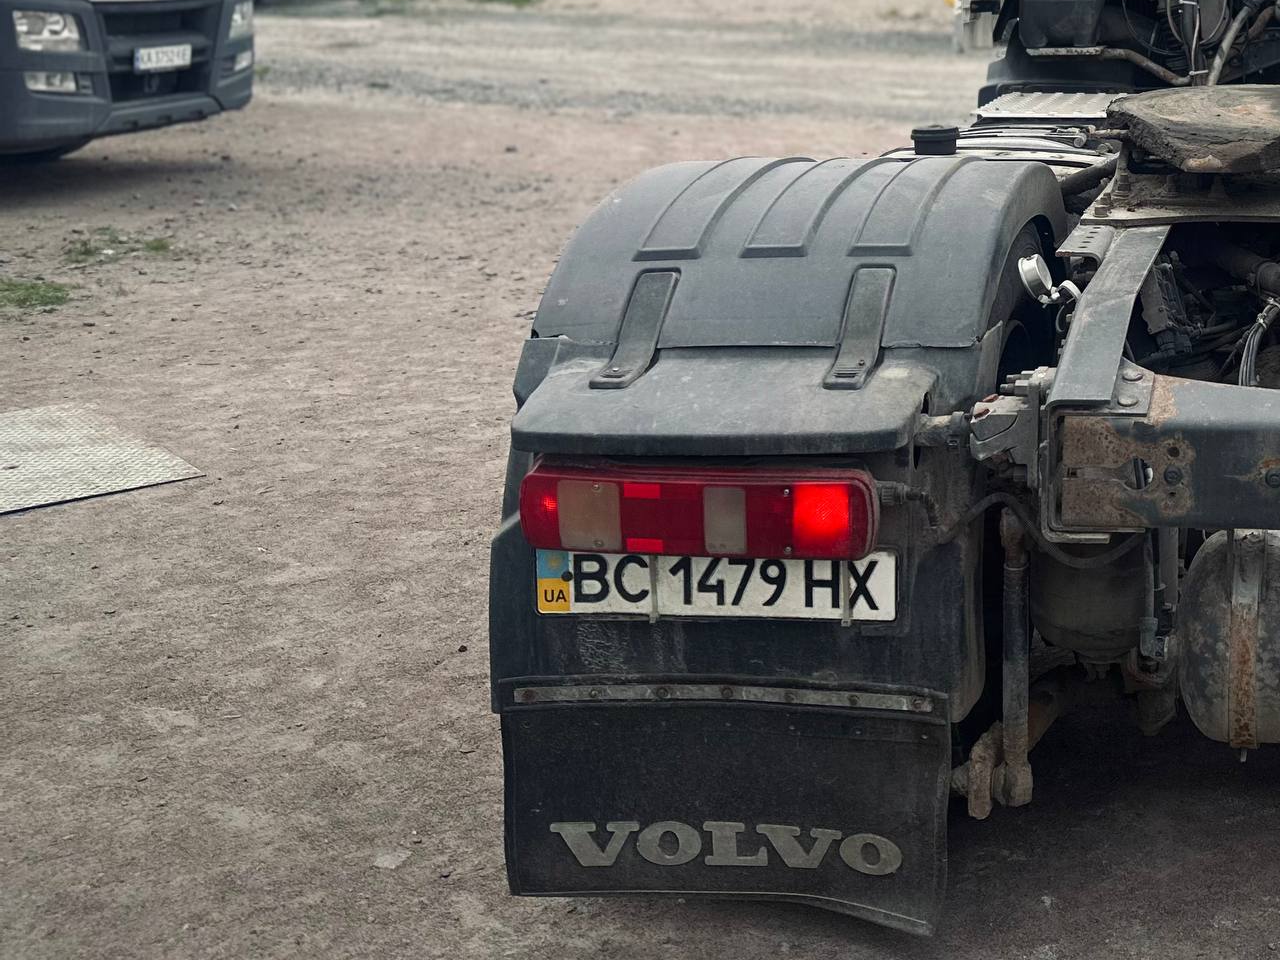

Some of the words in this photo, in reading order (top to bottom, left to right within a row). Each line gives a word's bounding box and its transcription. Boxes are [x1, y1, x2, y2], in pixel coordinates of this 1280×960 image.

[543, 589, 568, 603] UA
[573, 553, 650, 604] BC
[668, 555, 788, 607] 1479
[803, 558, 880, 611] HX
[550, 820, 903, 876] VOLVO
